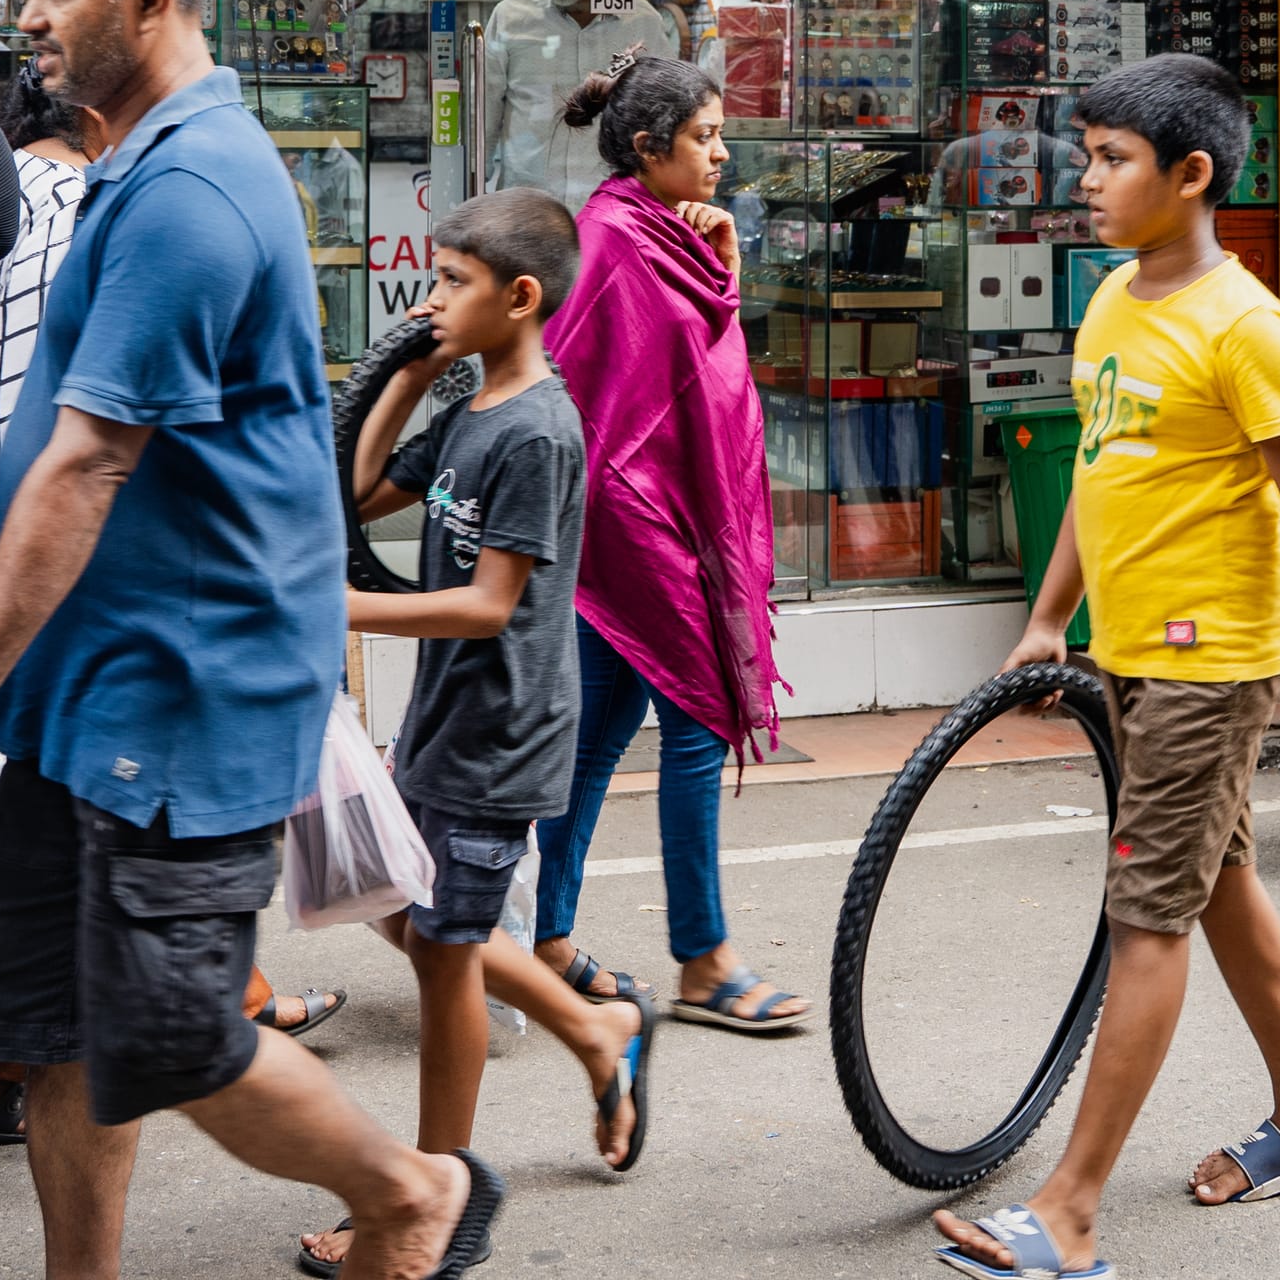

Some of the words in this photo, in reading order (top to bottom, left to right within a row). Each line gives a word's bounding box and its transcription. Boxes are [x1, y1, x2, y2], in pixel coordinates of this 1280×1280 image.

[1191, 12, 1211, 21] BIG
[1192, 37, 1212, 46] BIG
[440, 95, 450, 143] PUSH
